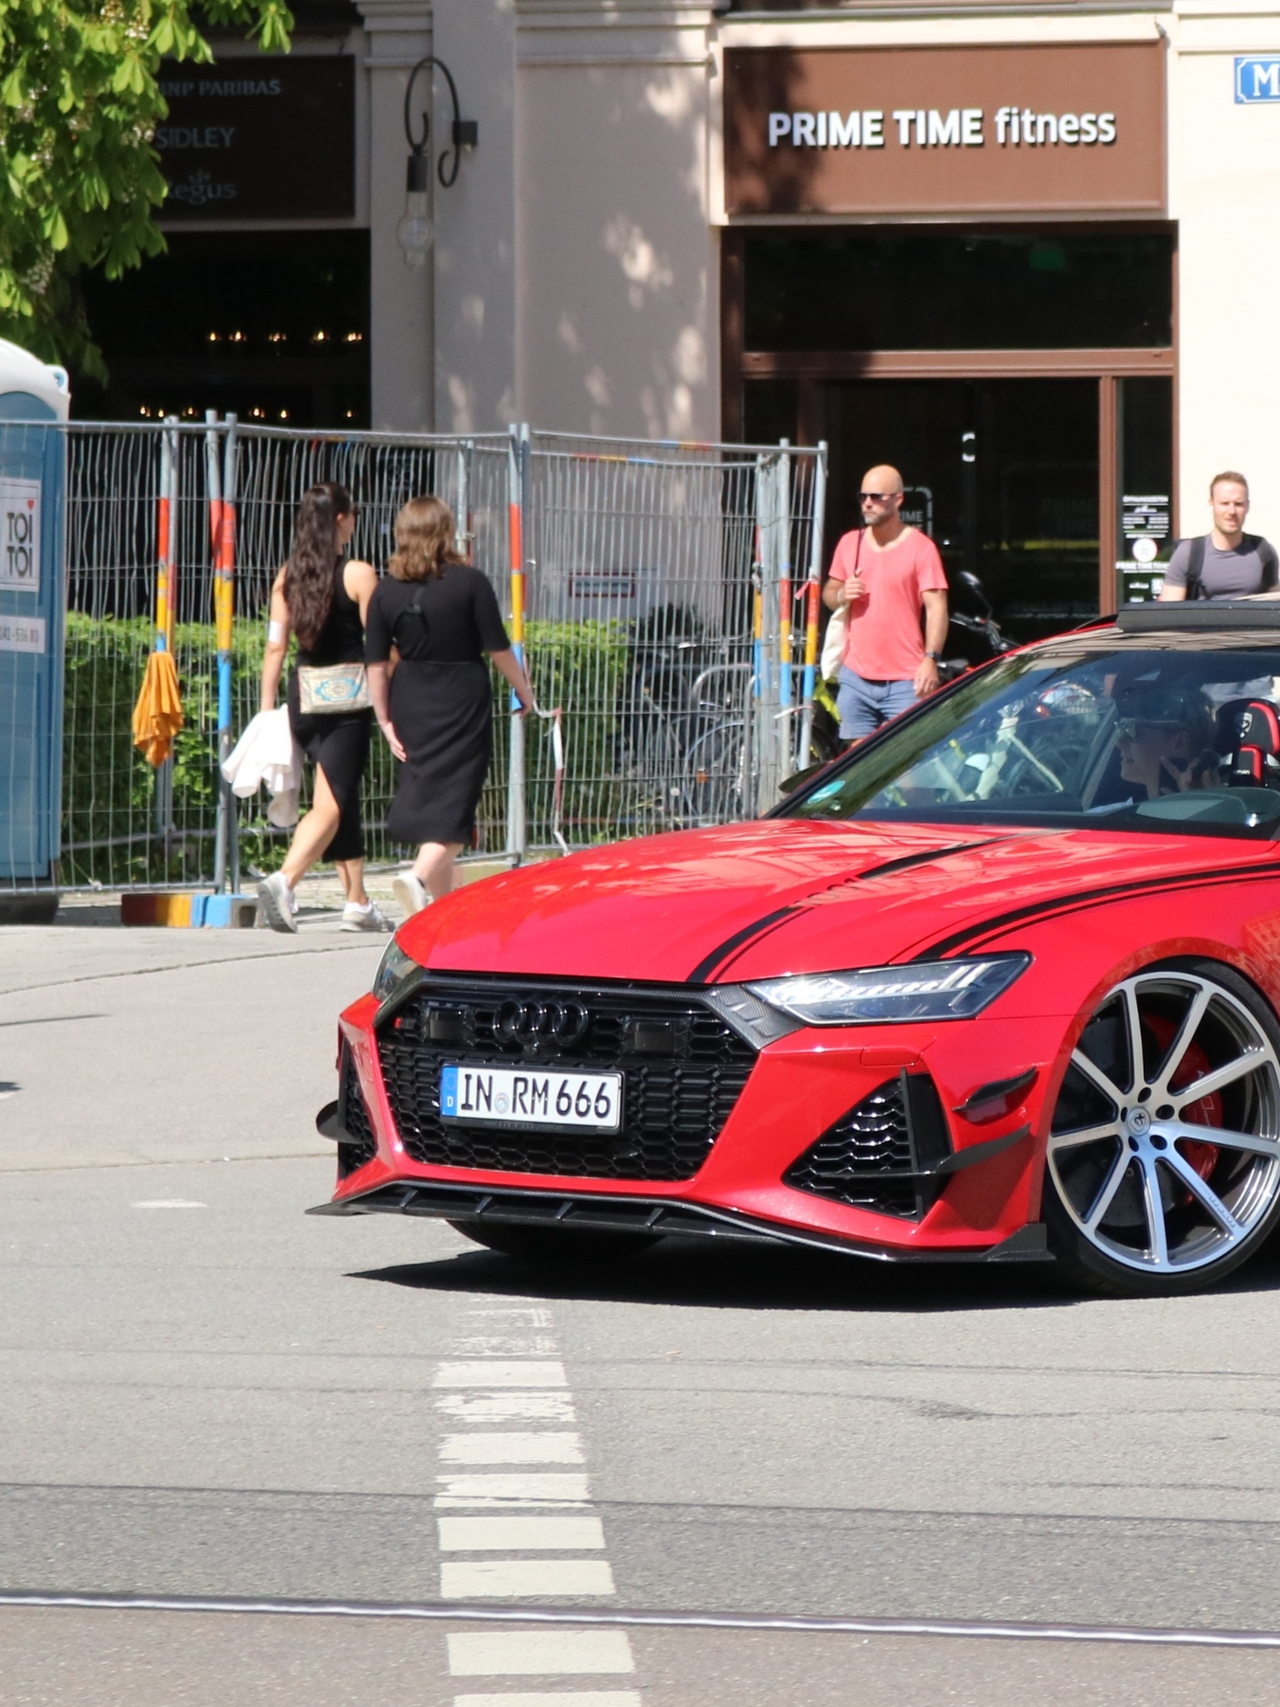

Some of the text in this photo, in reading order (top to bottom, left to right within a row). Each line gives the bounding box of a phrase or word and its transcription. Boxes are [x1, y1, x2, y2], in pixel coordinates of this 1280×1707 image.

[198, 79, 282, 97] PARIBAS
[155, 126, 236, 150] SIDLEY
[768, 106, 1116, 147] PRIME TIME fitness
[7, 512, 33, 545] TOI
[7, 545, 33, 578] TOI
[446, 1096, 454, 1108] D
[461, 1073, 612, 1119] IN RM 666
